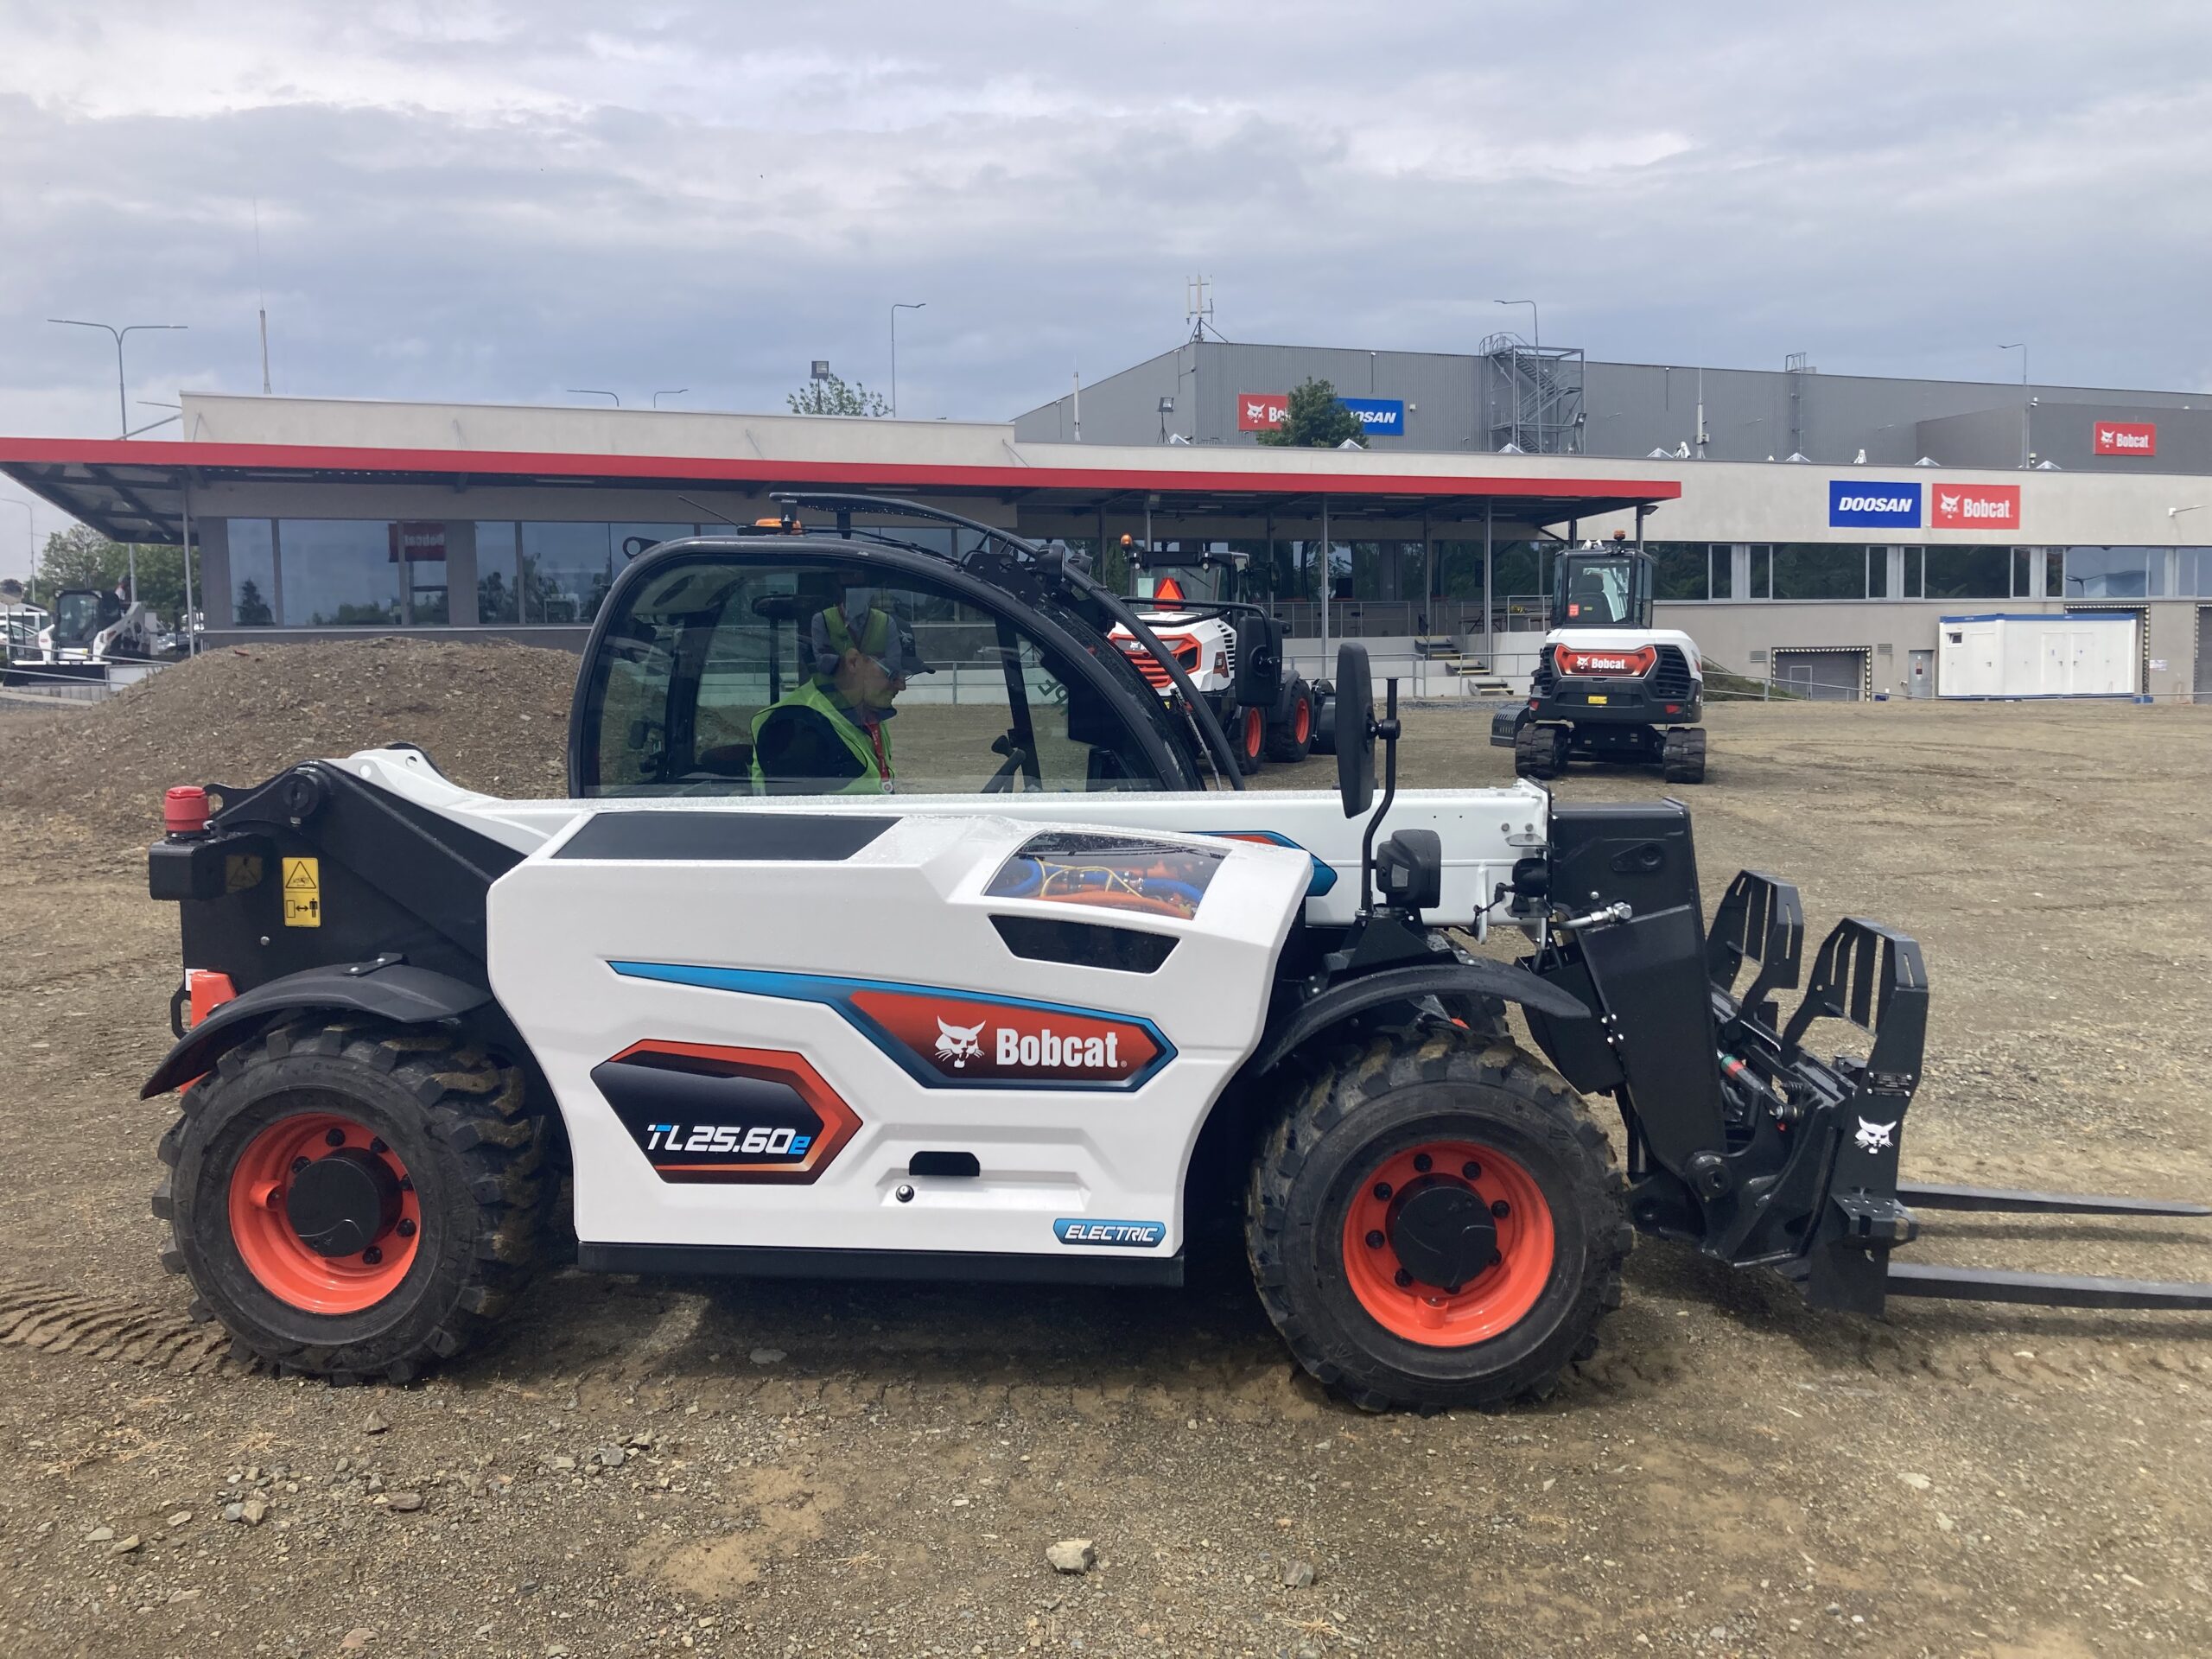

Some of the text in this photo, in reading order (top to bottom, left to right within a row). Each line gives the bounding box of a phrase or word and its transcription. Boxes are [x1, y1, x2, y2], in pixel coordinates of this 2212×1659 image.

[2116, 433, 2149, 448] Bobcat
[1839, 497, 1912, 512] DOOSAN
[1963, 499, 2011, 518] Bobcat
[1591, 658, 1625, 669] Bobcat
[996, 1028, 1118, 1068] Bobcat
[1065, 1224, 1158, 1243] ELECTRIC
